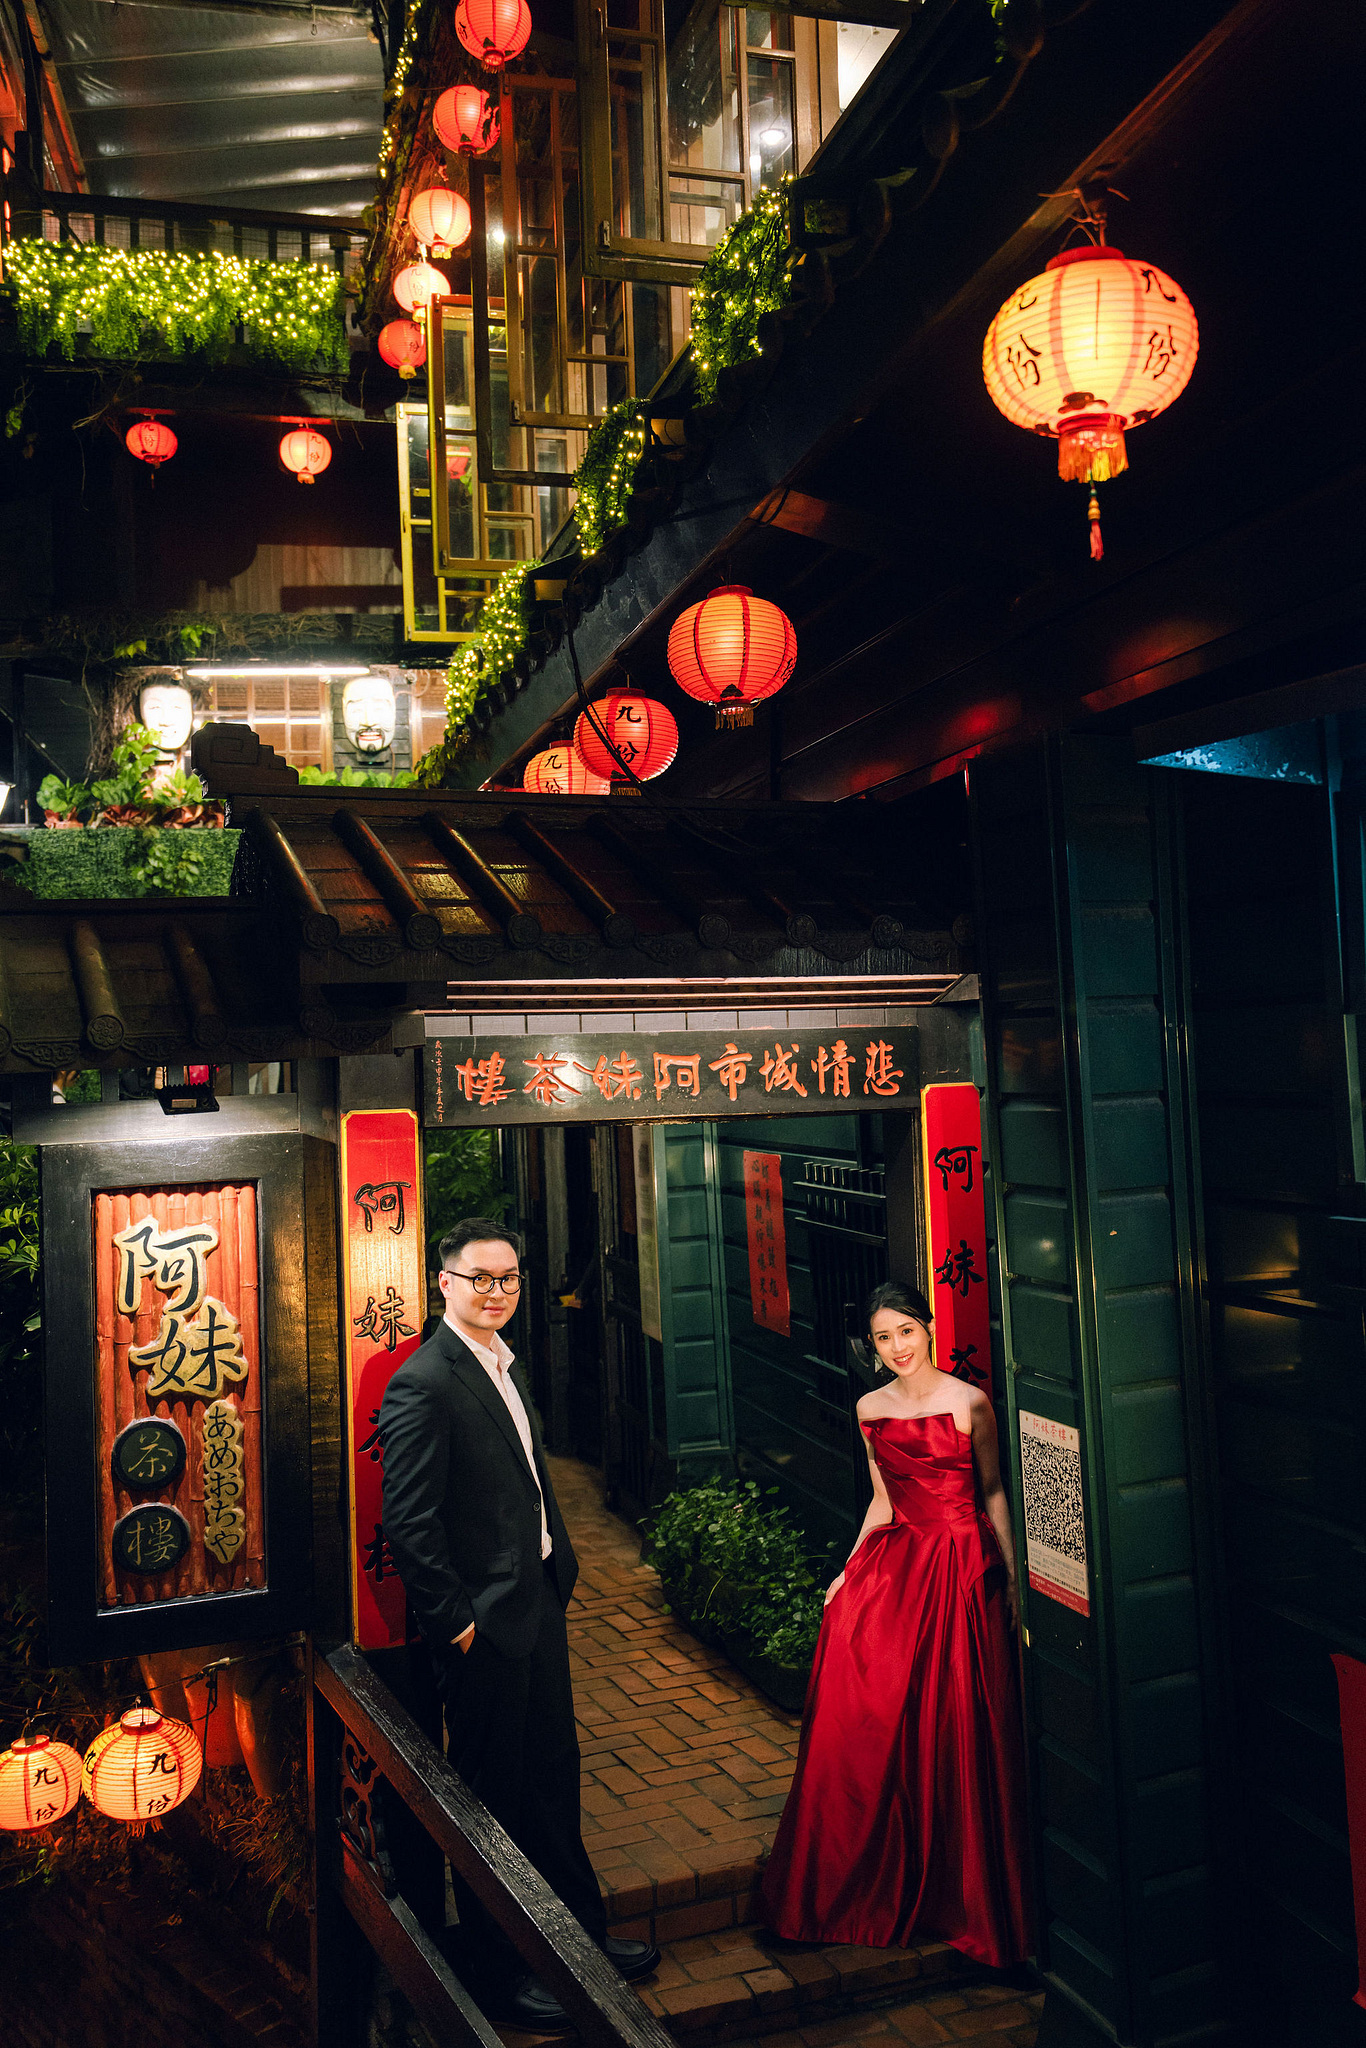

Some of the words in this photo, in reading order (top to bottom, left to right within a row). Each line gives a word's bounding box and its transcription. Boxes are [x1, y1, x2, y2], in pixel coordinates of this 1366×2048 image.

[1006, 288, 1042, 390] 九份
[1140, 268, 1177, 380] 九份
[309, 435, 321, 463] 九份
[614, 705, 642, 764] 九份
[545, 754, 564, 794] 九份
[116, 1225, 242, 1391] 阿妹
[1032, 1417, 1067, 1441] 阿妹茶樓
[33, 1767, 59, 1822] 九份
[146, 1752, 177, 1815] 九份
